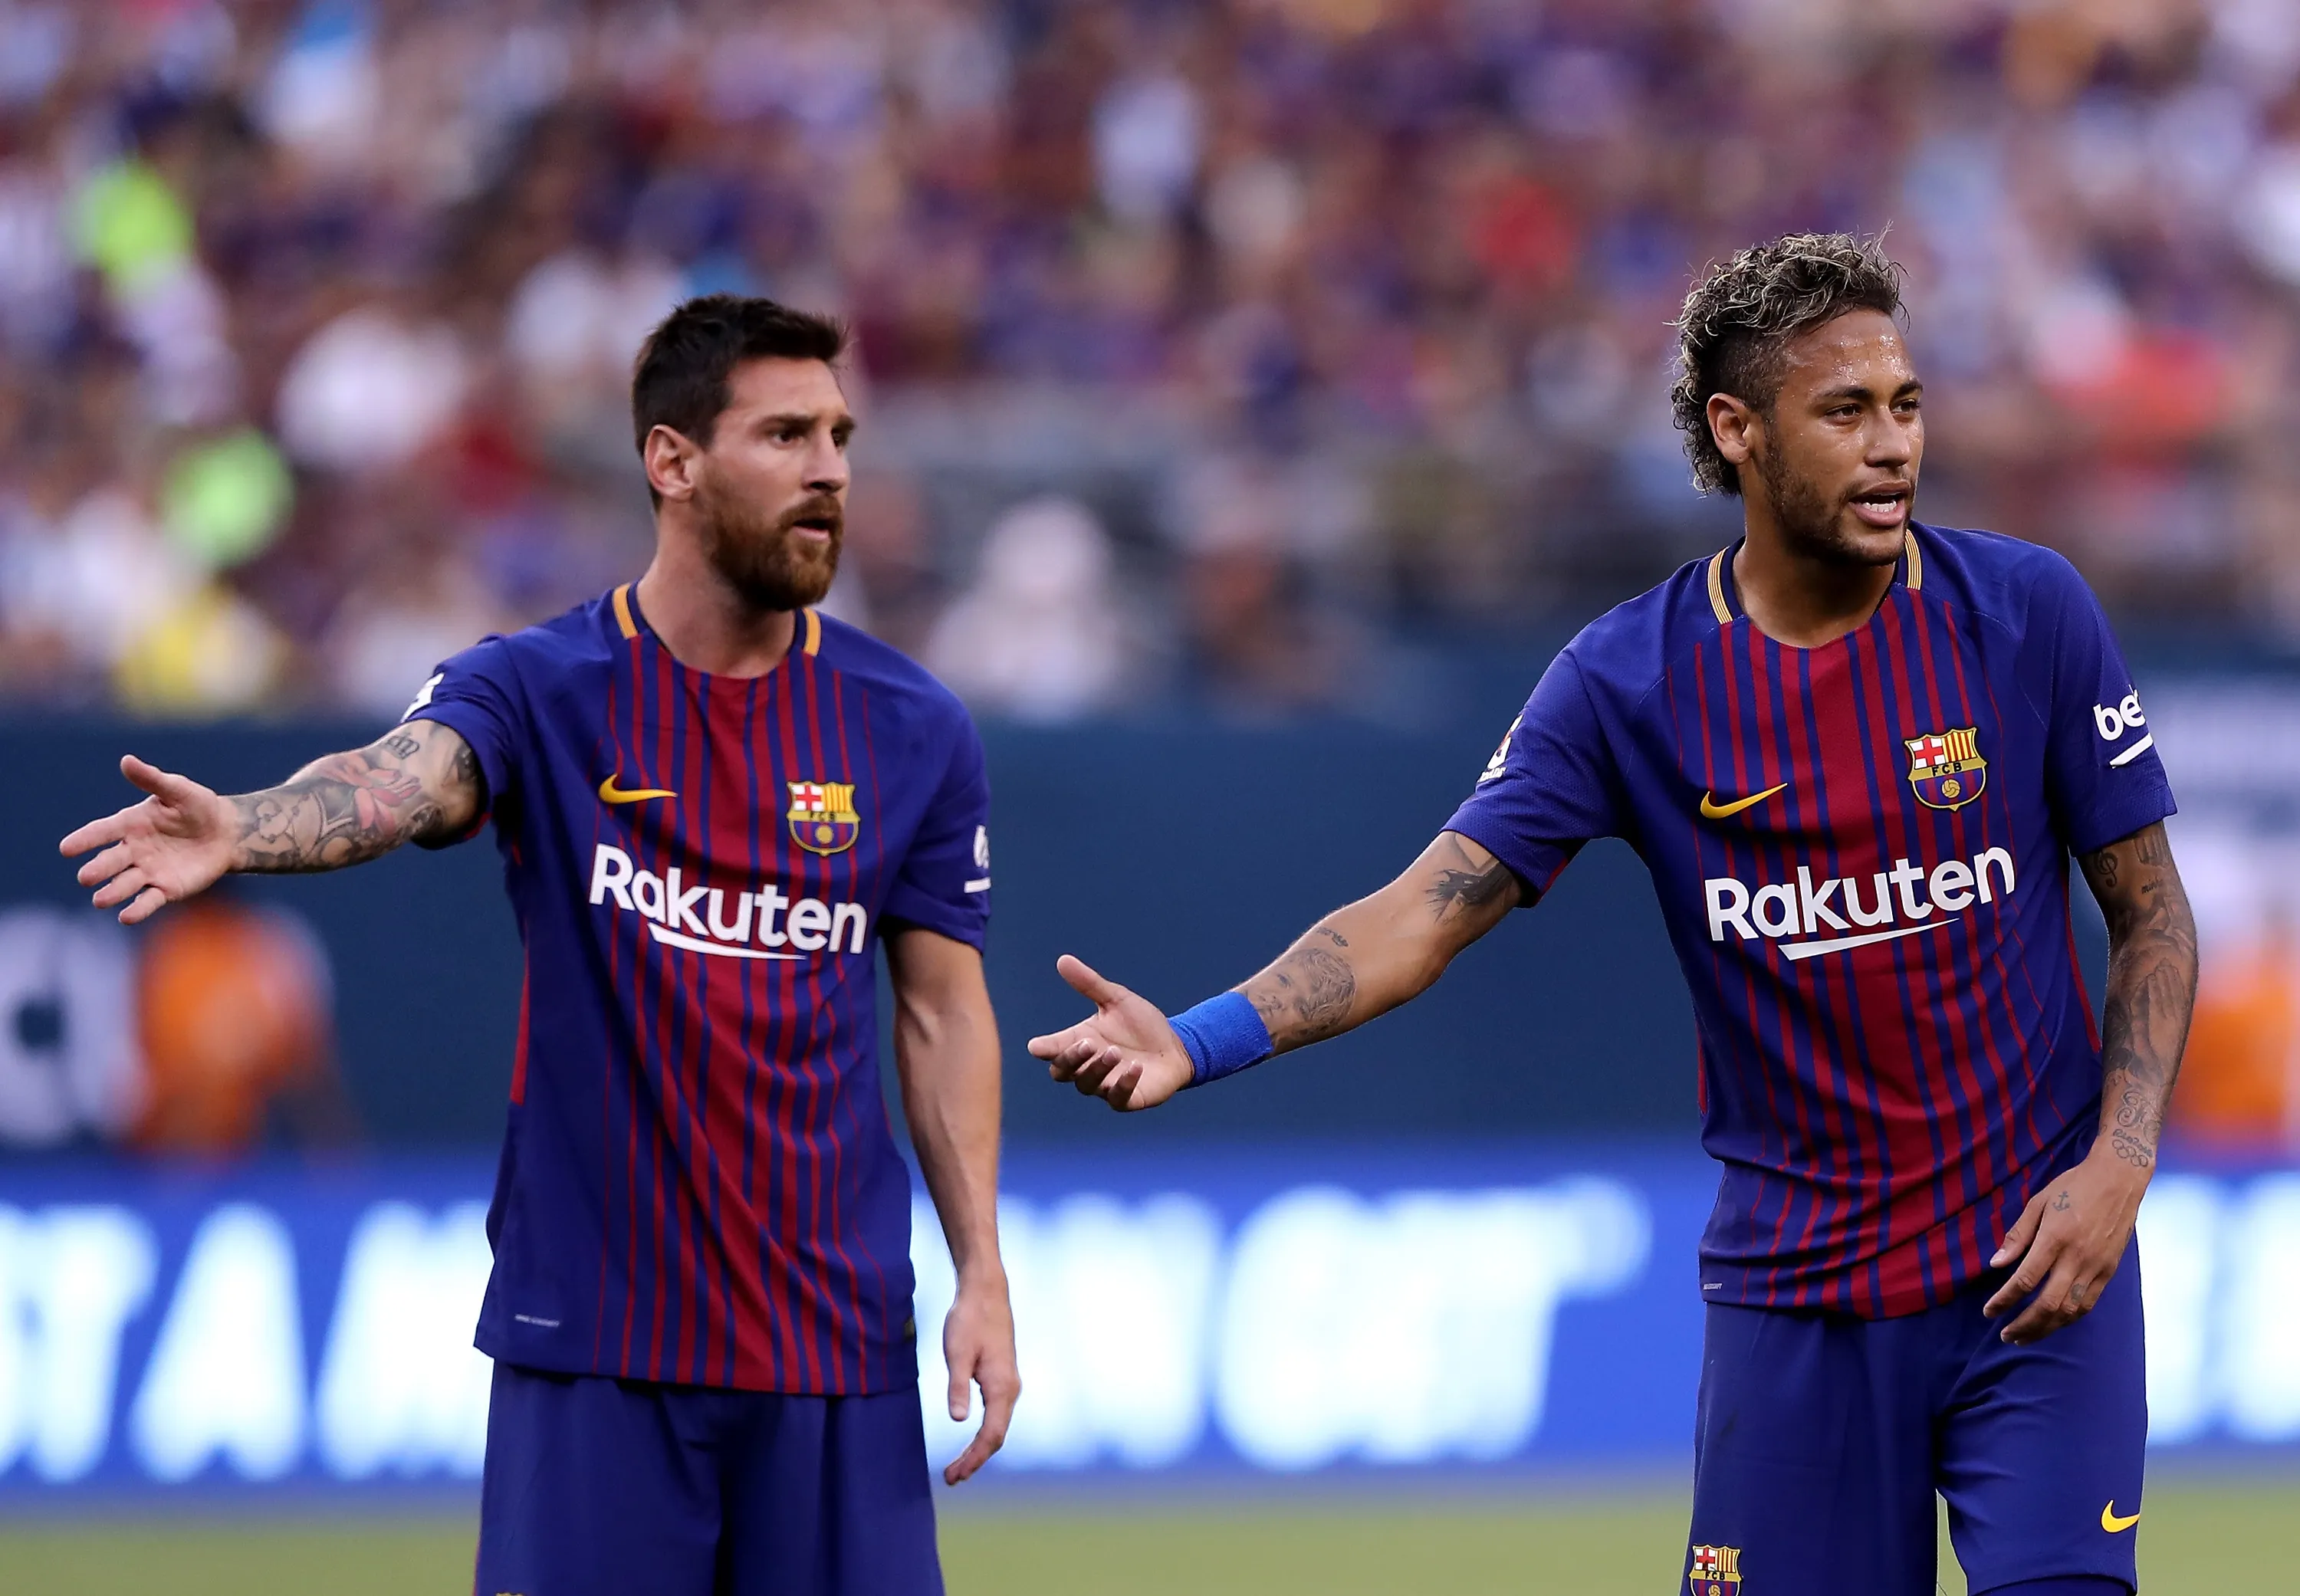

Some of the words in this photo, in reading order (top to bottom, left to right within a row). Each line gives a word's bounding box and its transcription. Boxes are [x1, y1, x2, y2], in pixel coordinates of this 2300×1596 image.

[2093, 685, 2146, 741] be
[1932, 762, 1962, 777] FCB
[590, 843, 867, 954] Rakuten
[1704, 846, 2015, 941] Rakuten
[1705, 1571, 1725, 1581] FCB
